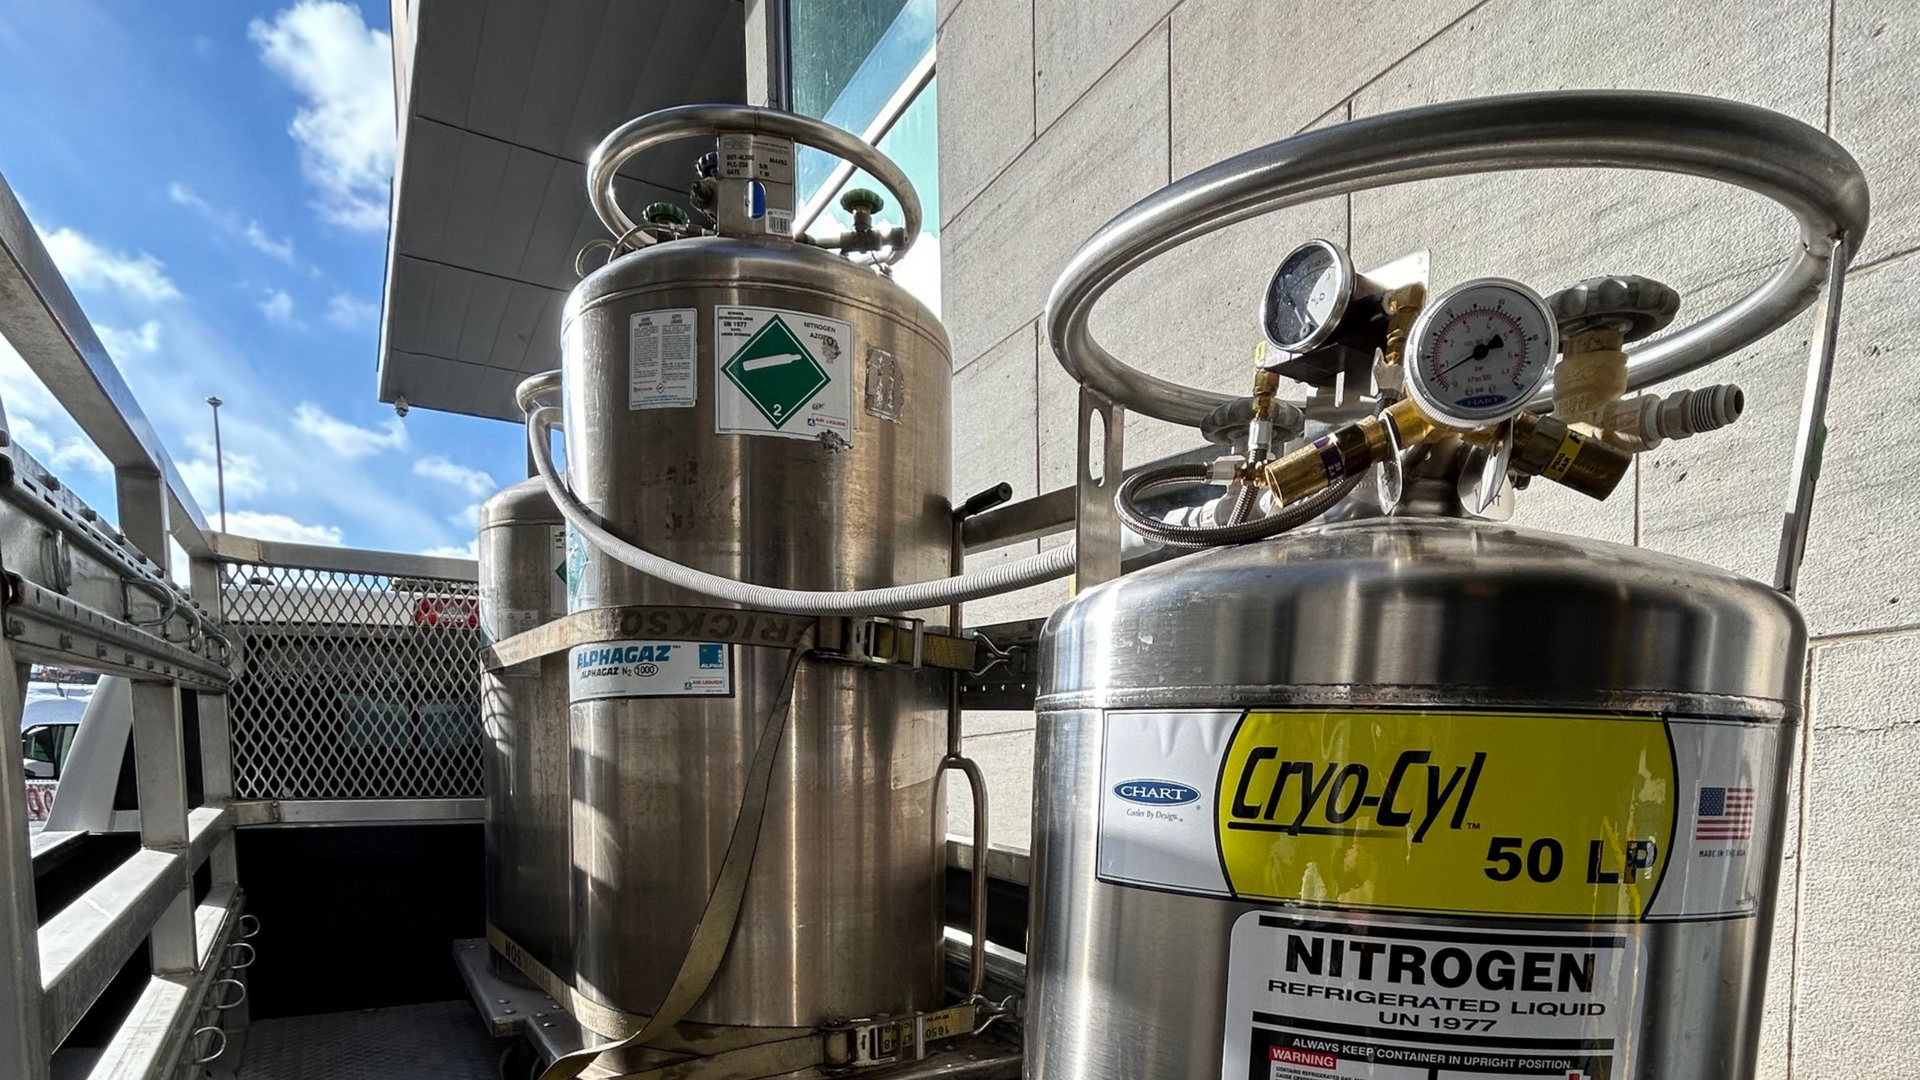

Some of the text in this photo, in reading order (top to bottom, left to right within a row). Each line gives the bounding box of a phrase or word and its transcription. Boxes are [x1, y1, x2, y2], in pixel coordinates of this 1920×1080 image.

[803, 321, 836, 333] NITROGEN
[773, 403, 782, 416] 2
[577, 645, 671, 669] ALPHAGAZ
[580, 667, 619, 680] ALPHAGAZ
[635, 665, 655, 674] 1000
[1120, 785, 1187, 801] CHART
[1231, 746, 1487, 843] Cryo-Cyl
[1126, 808, 1145, 817] Cooler
[1146, 810, 1154, 820] By
[1484, 836, 1658, 884] 50 LP
[1699, 849, 1715, 858] MADE
[1285, 934, 1596, 993] NITROGEN
[1268, 979, 1606, 1017] REFRIGERATED LIQUID
[1378, 1011, 1498, 1032] UN 1977
[925, 1025, 949, 1038] 1650
[1272, 1048, 1334, 1068] WARNING
[1292, 1038, 1574, 1070] ALWAYS KEEP CONTAINER IN UPRIGHT POSITION.
[1275, 1066, 1301, 1075] CONTAINS
[1302, 1070, 1340, 1080] REFRIGERATED
